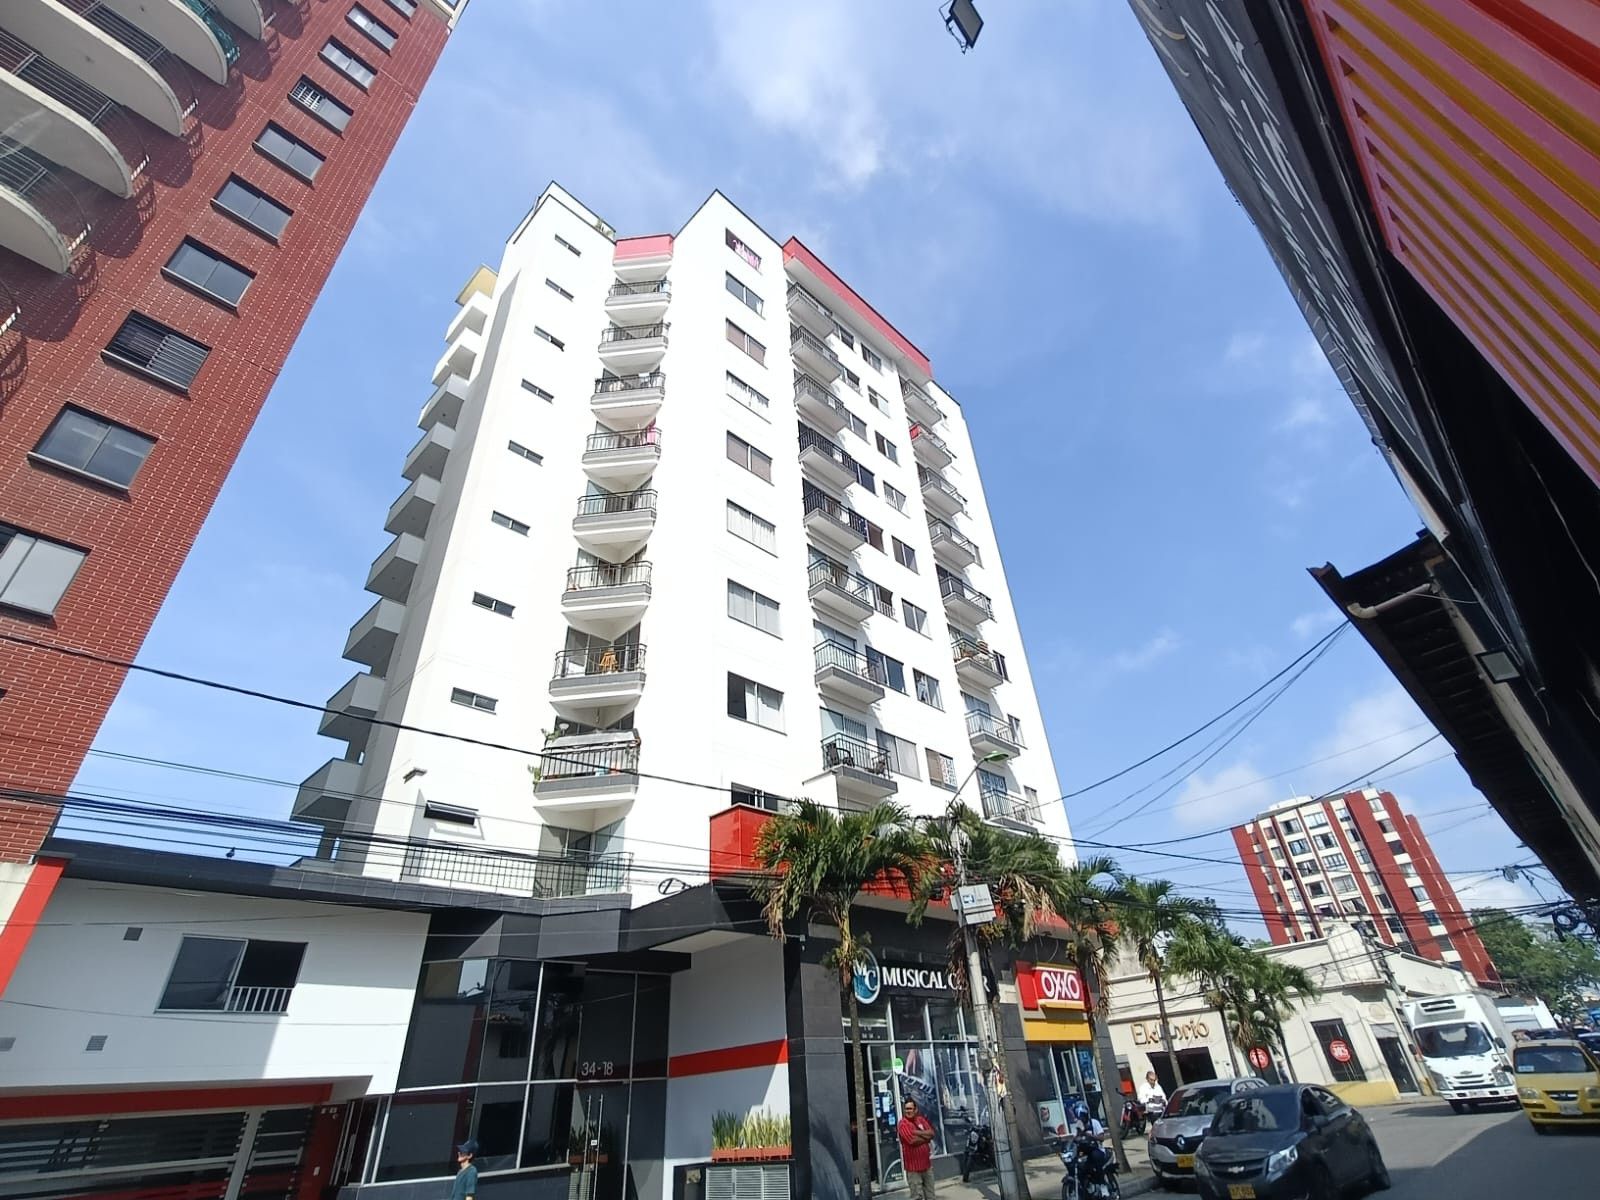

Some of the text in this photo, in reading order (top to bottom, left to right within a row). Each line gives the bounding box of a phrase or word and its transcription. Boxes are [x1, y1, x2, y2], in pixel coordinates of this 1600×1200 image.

[882, 966, 947, 990] MUSICAL
[1041, 971, 1080, 1000] OXXO
[581, 1061, 614, 1077] 34-18
